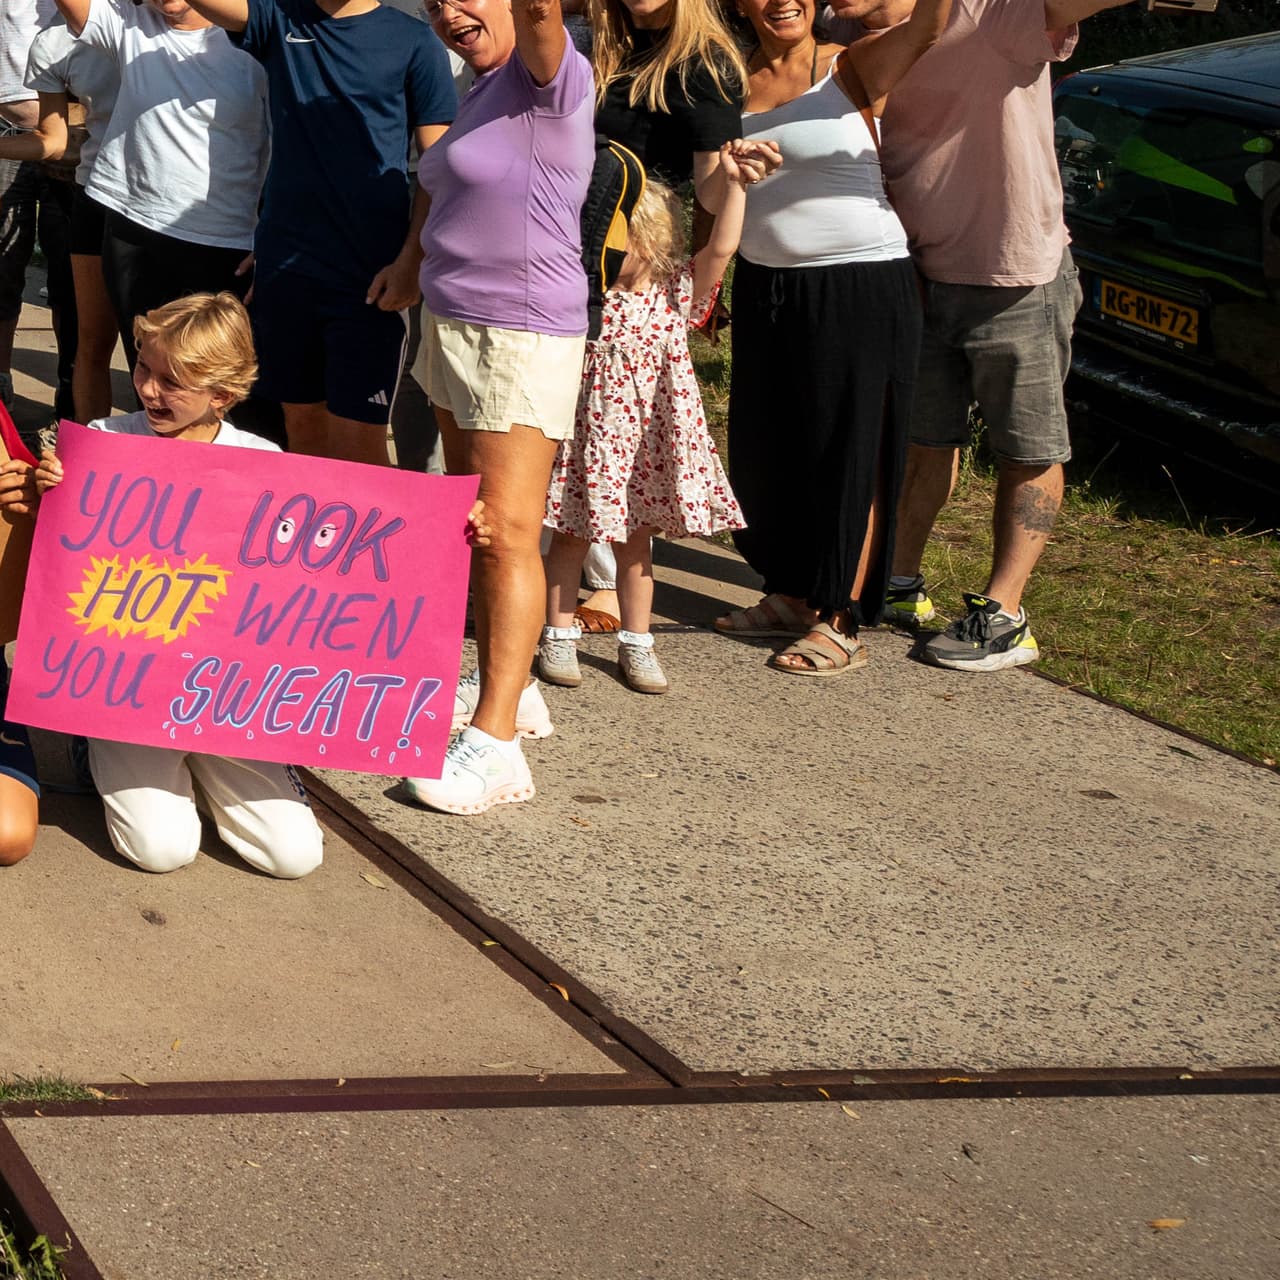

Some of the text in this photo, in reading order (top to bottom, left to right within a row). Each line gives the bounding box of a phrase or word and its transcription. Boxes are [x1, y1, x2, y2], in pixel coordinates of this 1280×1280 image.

[1105, 285, 1194, 338] RG-RN-72
[59, 470, 406, 583] YOU LOOK
[83, 566, 425, 661] HOT WHEN
[36, 636, 443, 749] YOU SWEAT!
